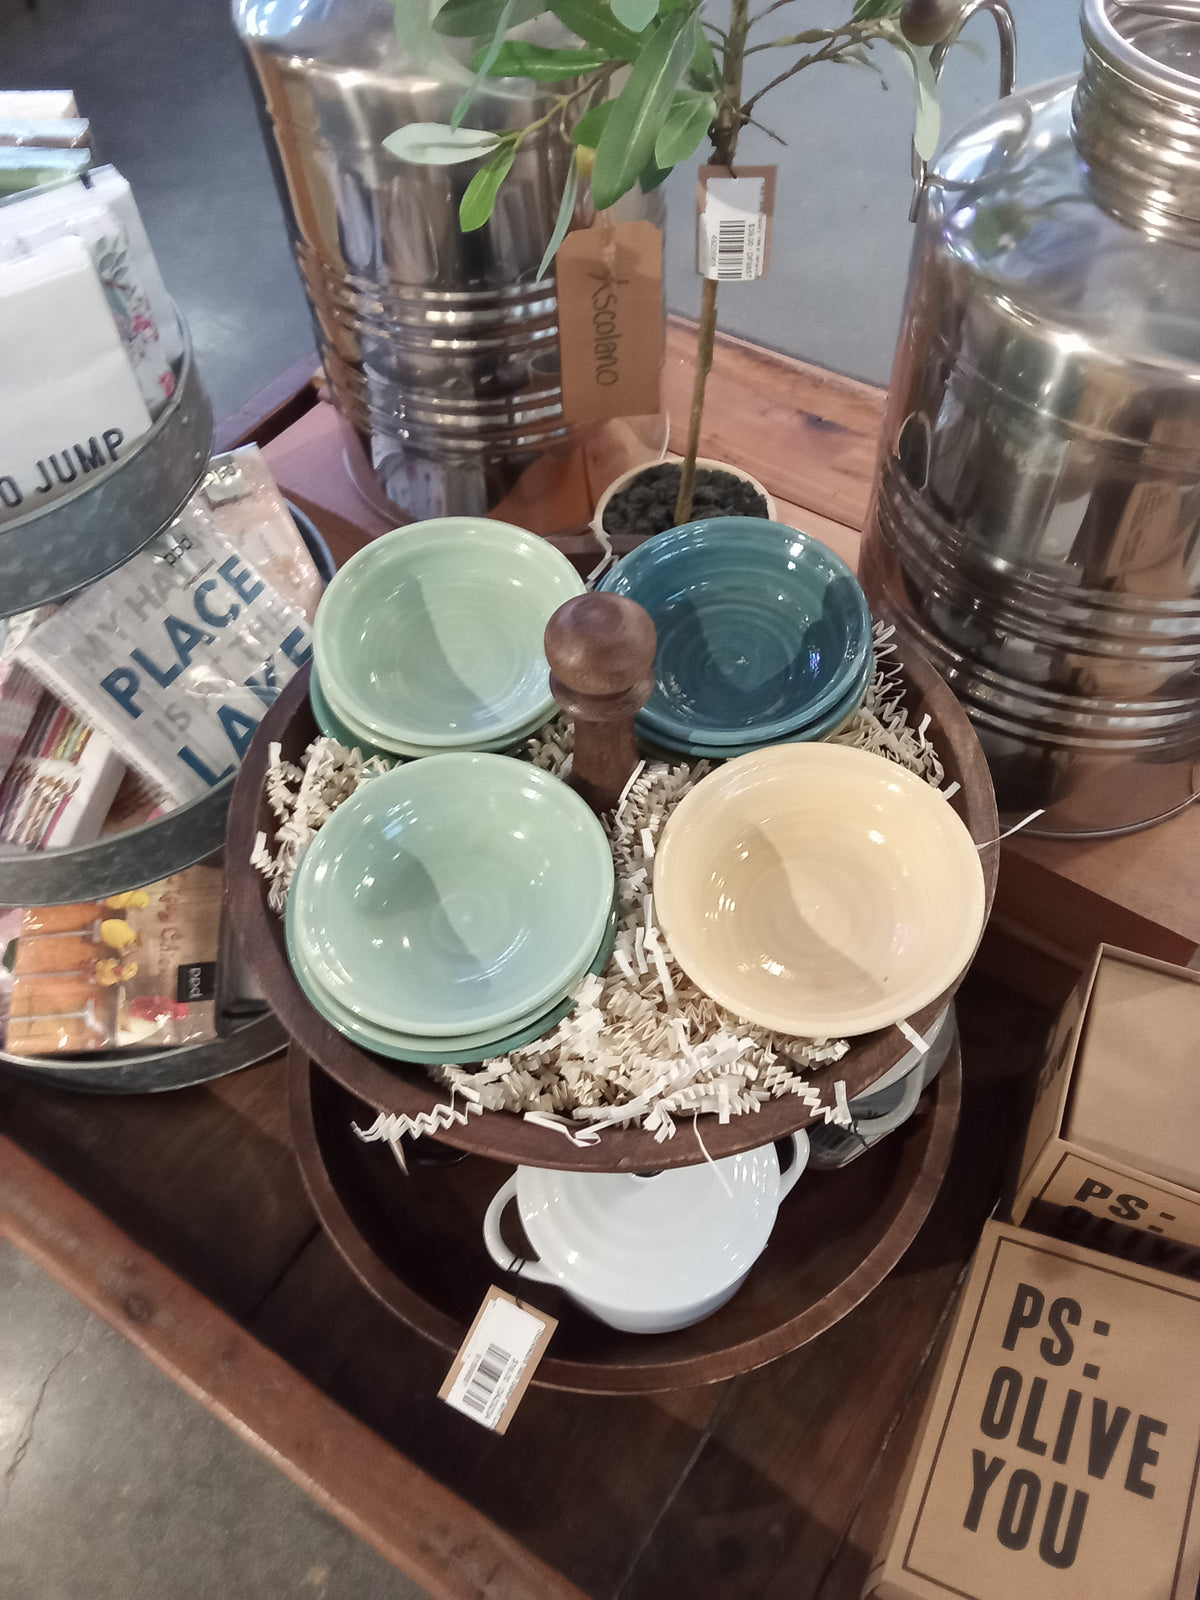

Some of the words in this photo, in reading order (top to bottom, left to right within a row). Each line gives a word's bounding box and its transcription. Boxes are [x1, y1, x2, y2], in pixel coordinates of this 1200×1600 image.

[35, 427, 125, 493] JUMP
[100, 554, 266, 720] PLACE
[153, 701, 193, 742] IS
[1074, 1176, 1176, 1234] PS:
[1001, 1282, 1110, 1380] PS:
[979, 1365, 1168, 1499] OLIVE
[962, 1448, 1090, 1569] YOU
